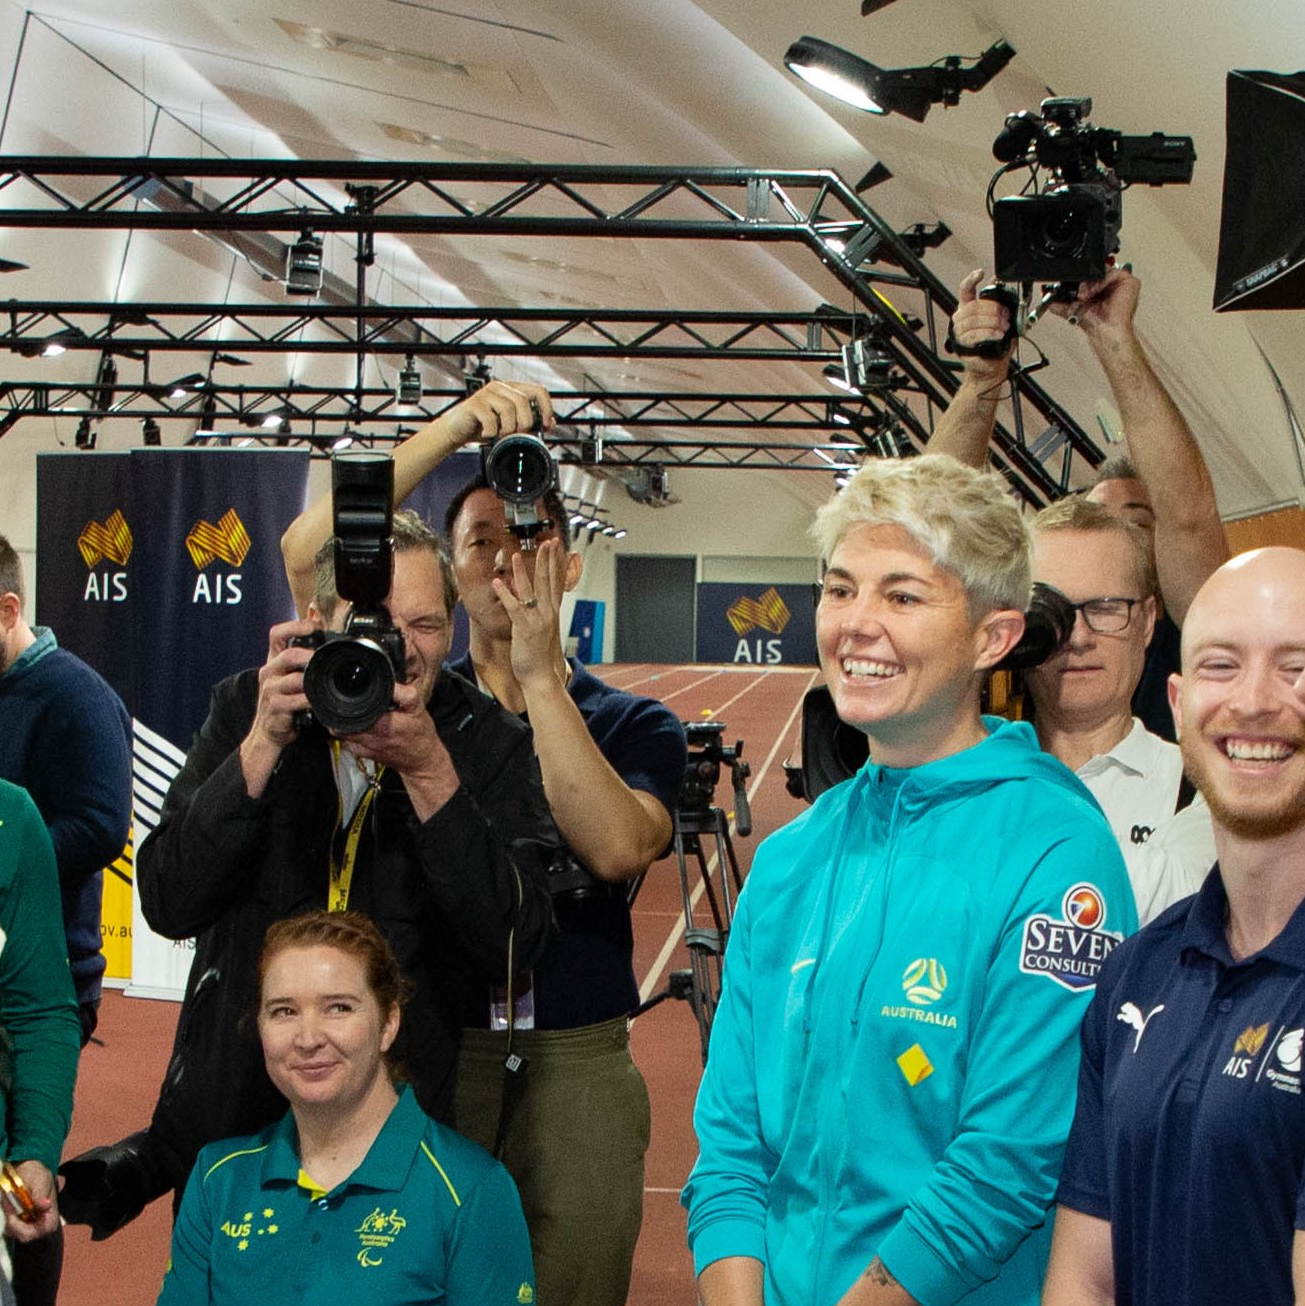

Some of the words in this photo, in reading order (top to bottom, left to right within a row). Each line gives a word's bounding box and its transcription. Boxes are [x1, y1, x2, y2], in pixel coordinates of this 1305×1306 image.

[83, 572, 128, 602] AIS
[193, 573, 243, 605] AIS
[734, 638, 783, 664] AIS
[1027, 920, 1119, 961] SEVEN
[881, 1005, 957, 1030] AUSTRALIA
[1222, 1056, 1252, 1078] AIS
[220, 1220, 252, 1238] AUS
